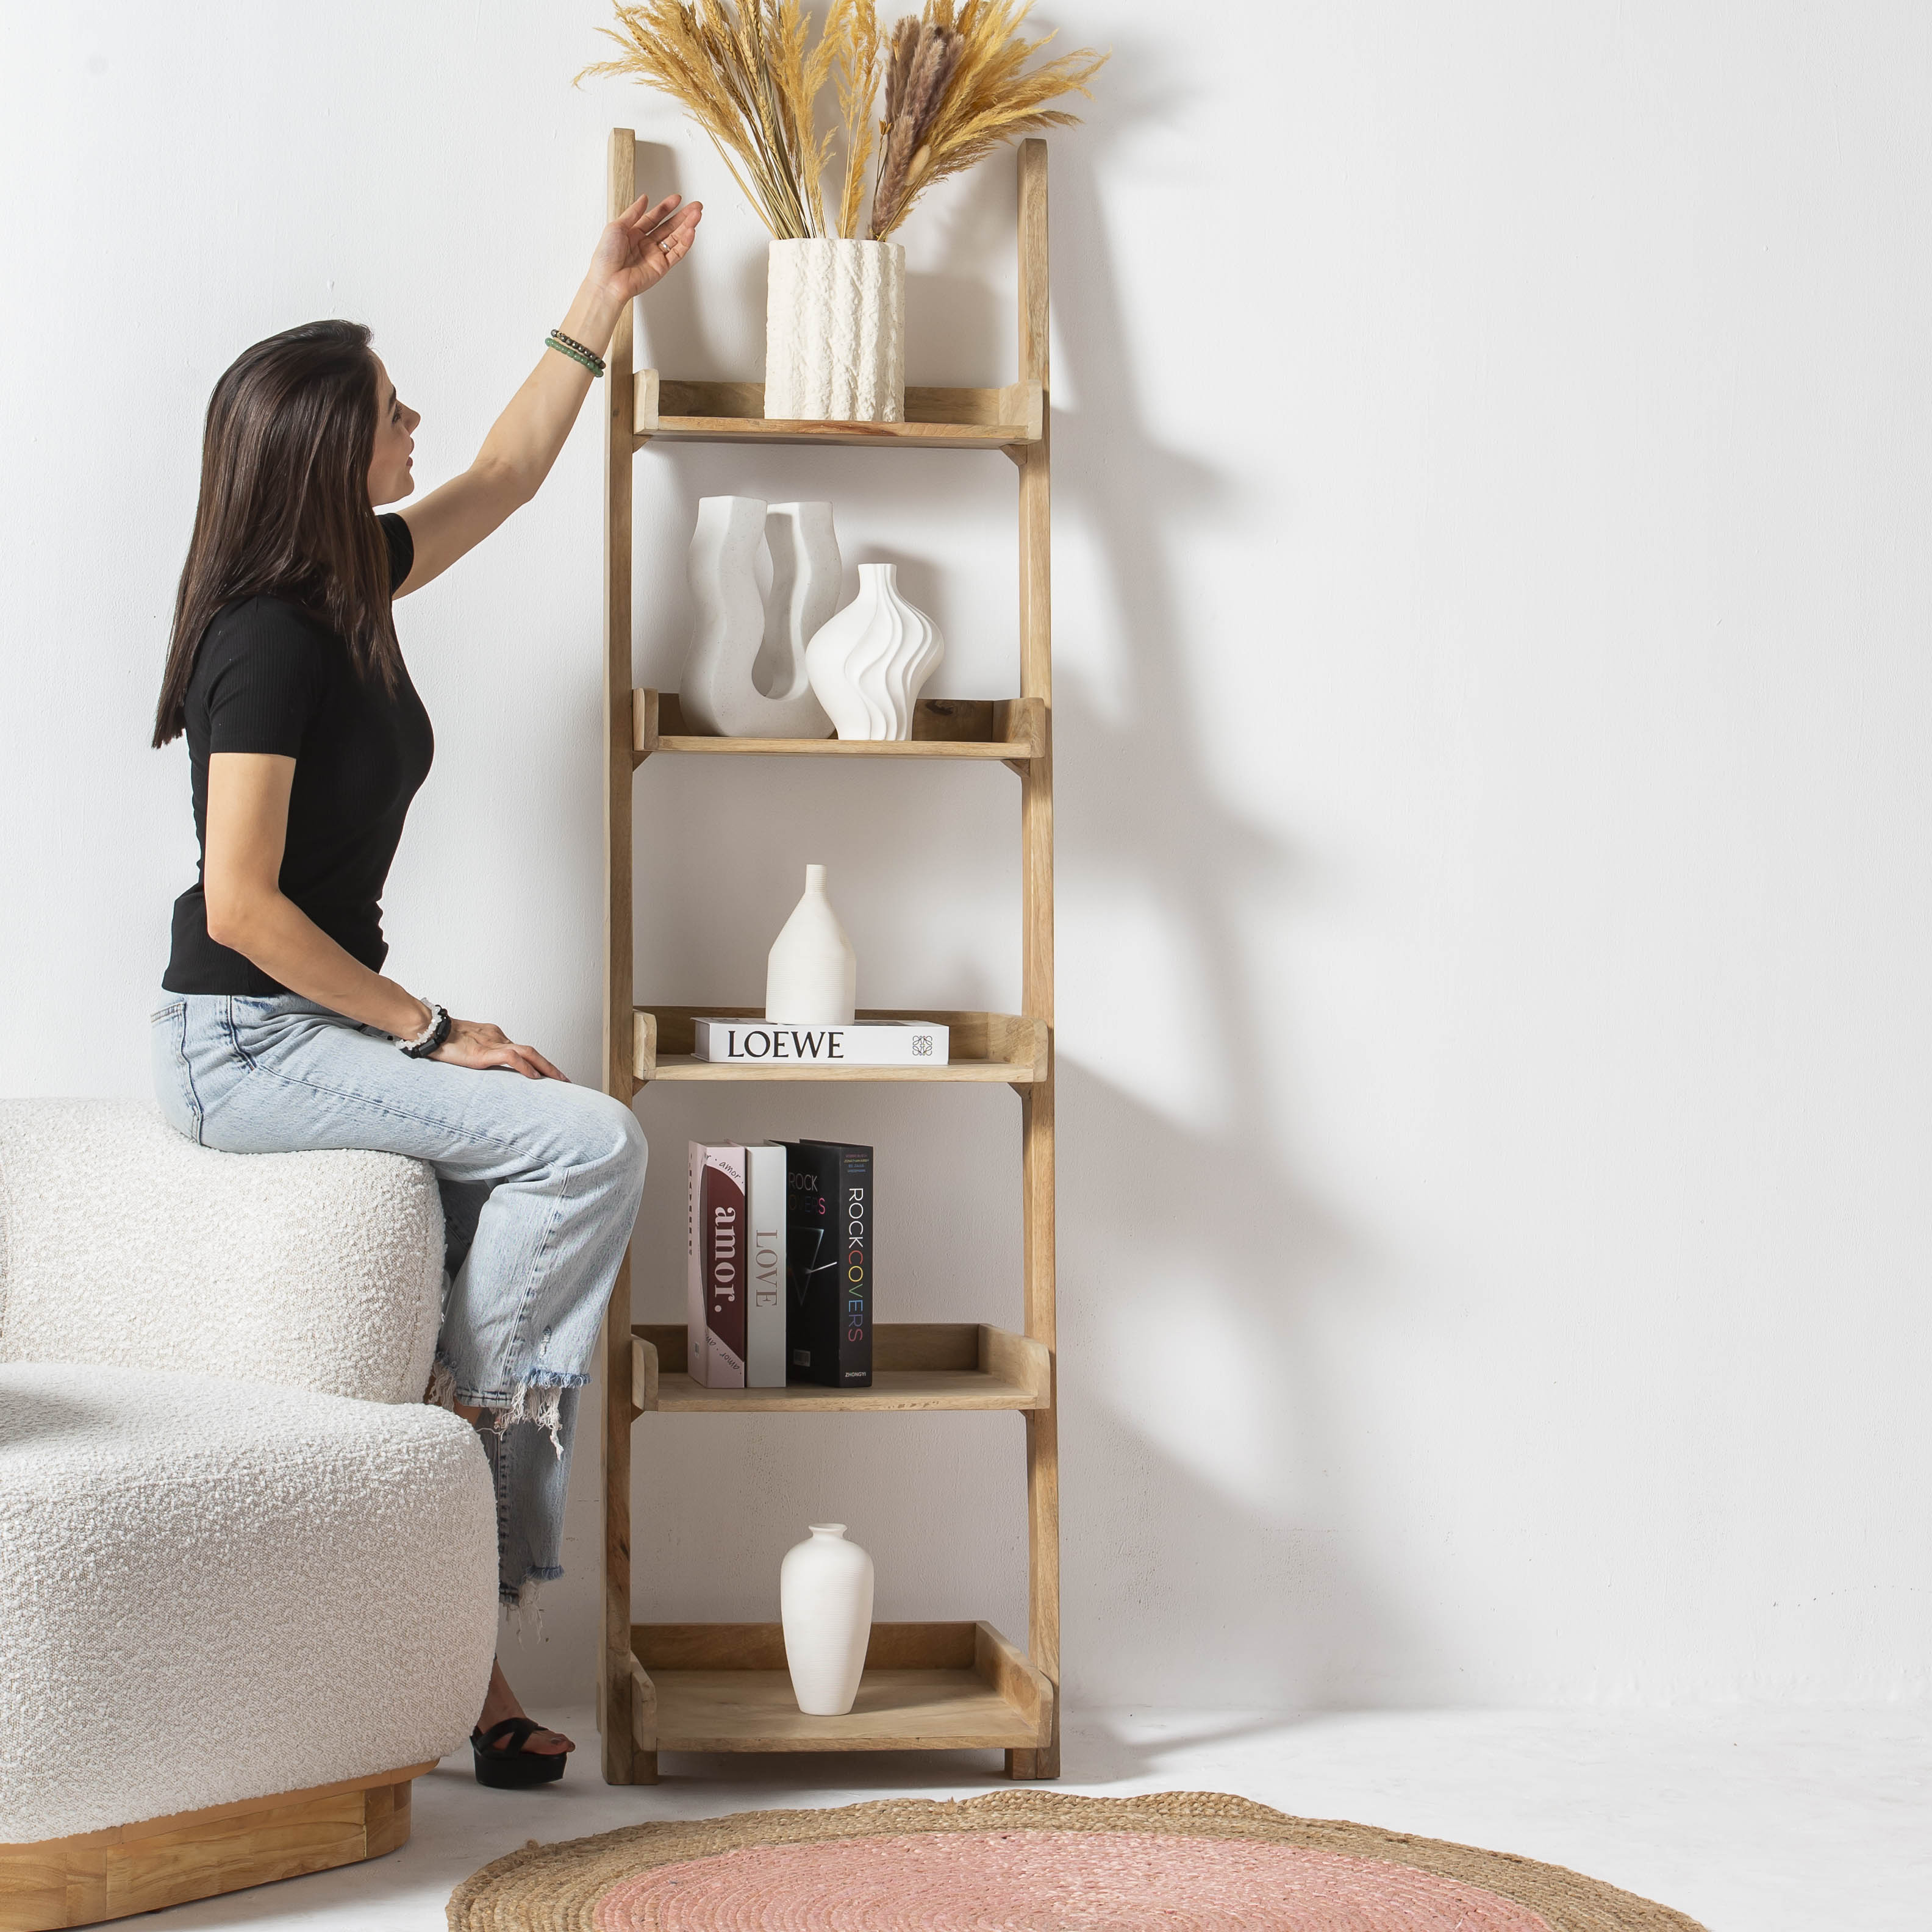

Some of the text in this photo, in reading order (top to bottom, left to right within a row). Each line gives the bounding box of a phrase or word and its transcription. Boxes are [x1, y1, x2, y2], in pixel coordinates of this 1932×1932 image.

[728, 1031, 844, 1059] LOEWE
[719, 1162, 741, 1179] amor
[789, 1172, 818, 1192] ROCK
[756, 1229, 778, 1307] LOVE
[720, 1352, 740, 1370] amor
